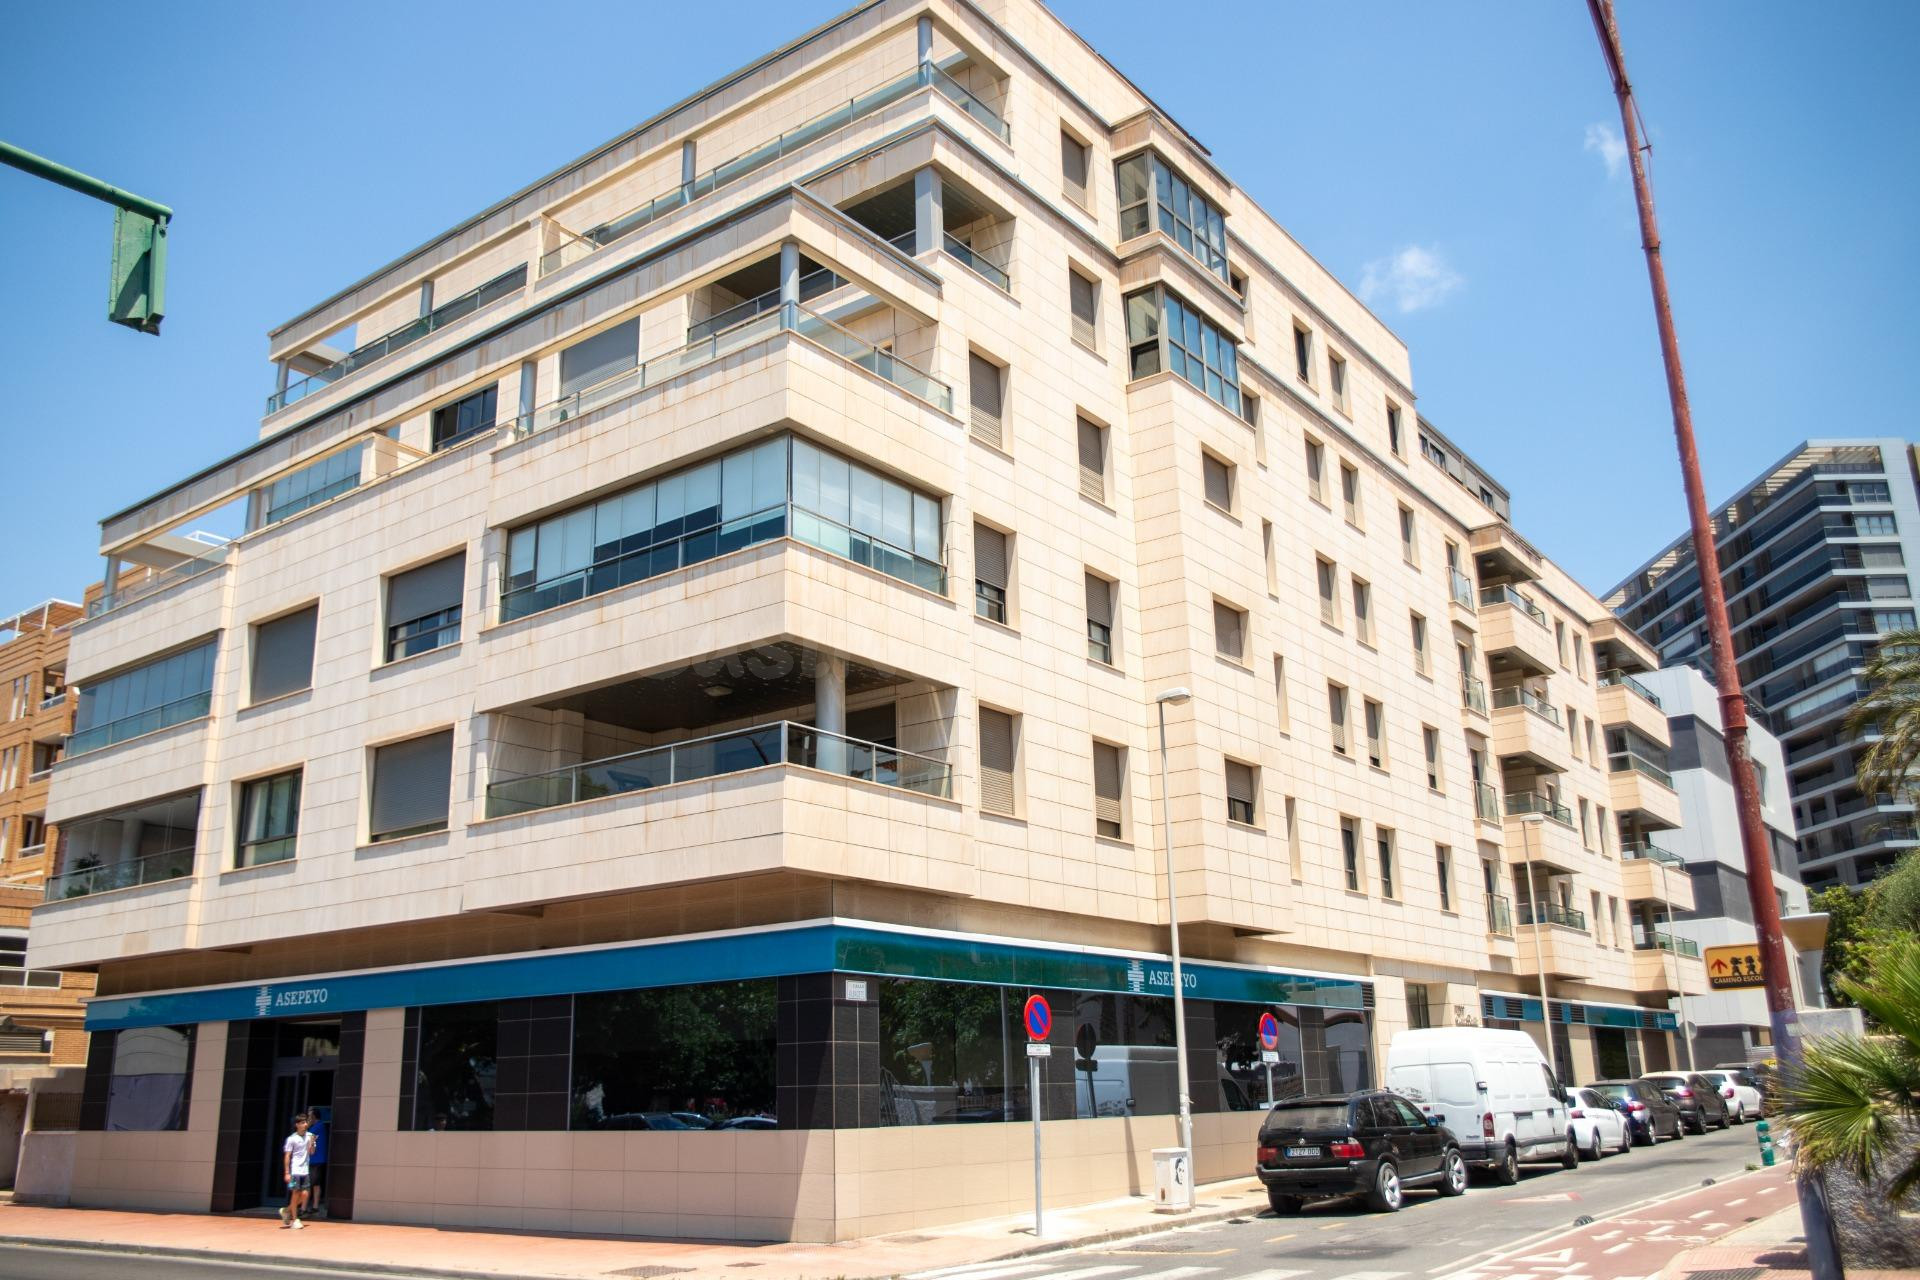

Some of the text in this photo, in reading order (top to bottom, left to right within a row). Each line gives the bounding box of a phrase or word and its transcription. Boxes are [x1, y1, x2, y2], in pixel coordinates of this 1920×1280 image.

[1148, 969, 1197, 988] ASEYO
[1714, 976, 1742, 984] CAMINO
[275, 988, 328, 1007] ASEPEYO
